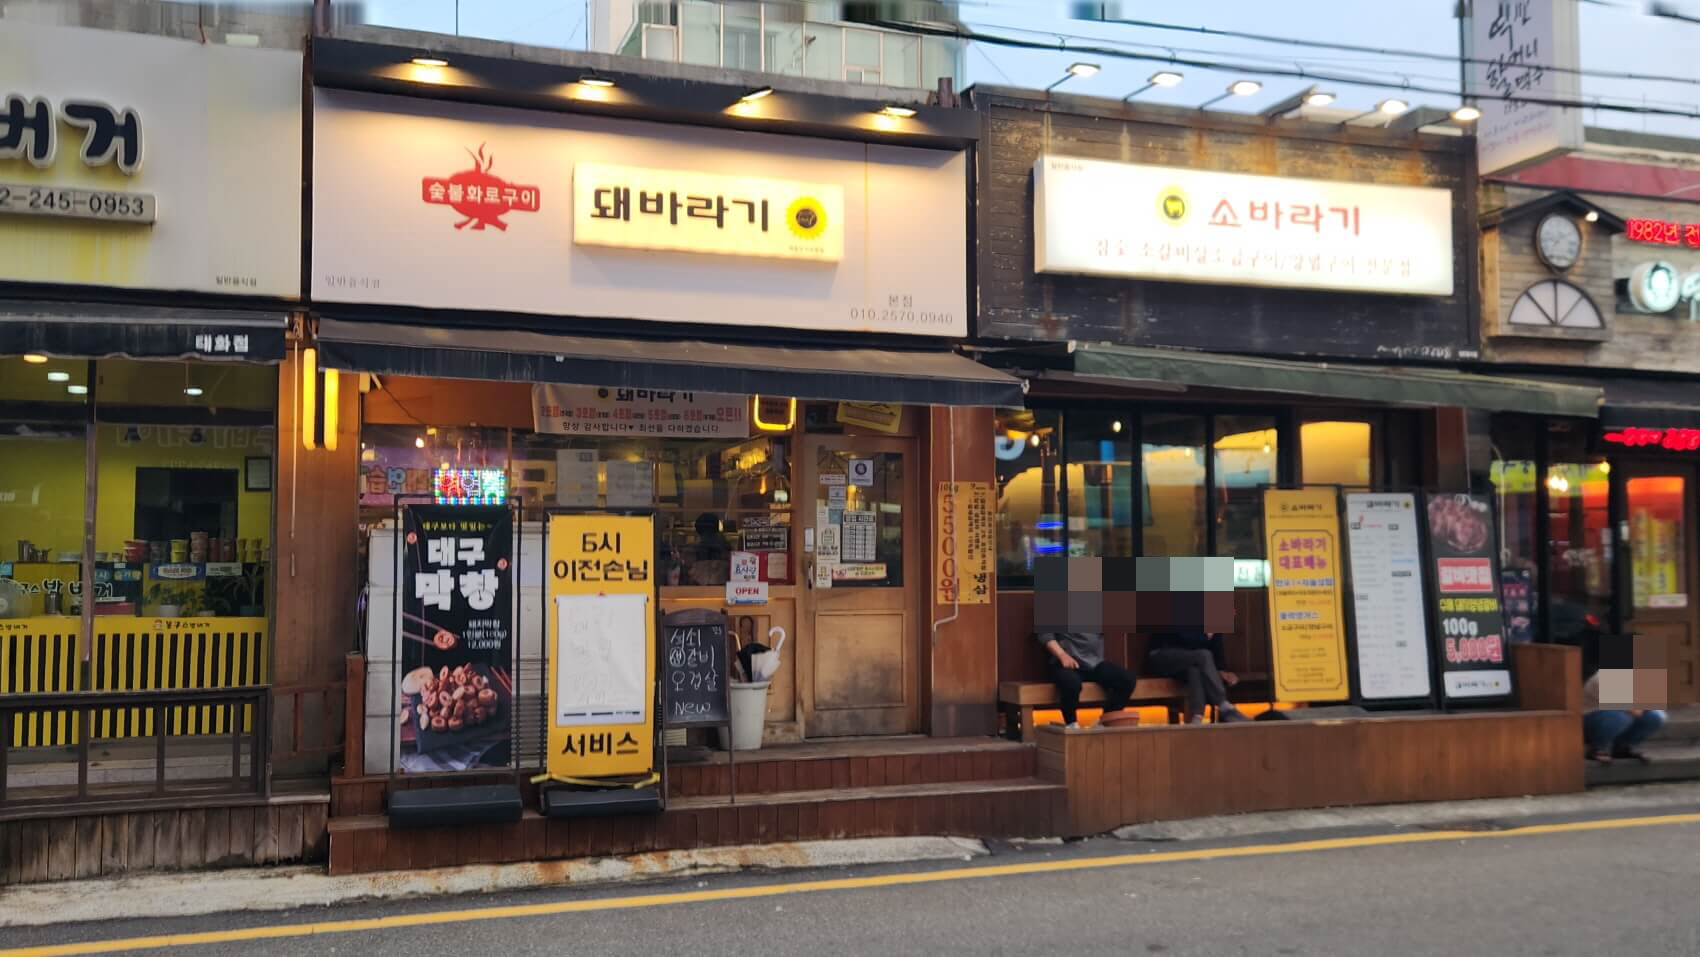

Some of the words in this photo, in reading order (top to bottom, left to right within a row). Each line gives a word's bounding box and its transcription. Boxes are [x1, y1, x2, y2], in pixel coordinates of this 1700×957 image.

[428, 181, 536, 209] 숯불화로구이
[590, 185, 769, 233] 돼바라기
[1208, 198, 1360, 236] 소바라기
[1628, 219, 1680, 245] 1982년
[888, 294, 914, 308] 본점
[427, 536, 485, 567] 대구
[581, 531, 621, 555] 6시
[1279, 537, 1328, 552] 소바라기
[553, 560, 649, 583] 이전손님
[415, 568, 499, 611] 막창
[735, 587, 759, 596] OPEN
[1442, 617, 1479, 636] 100g
[675, 701, 711, 717] New
[561, 730, 640, 758] 서비스
